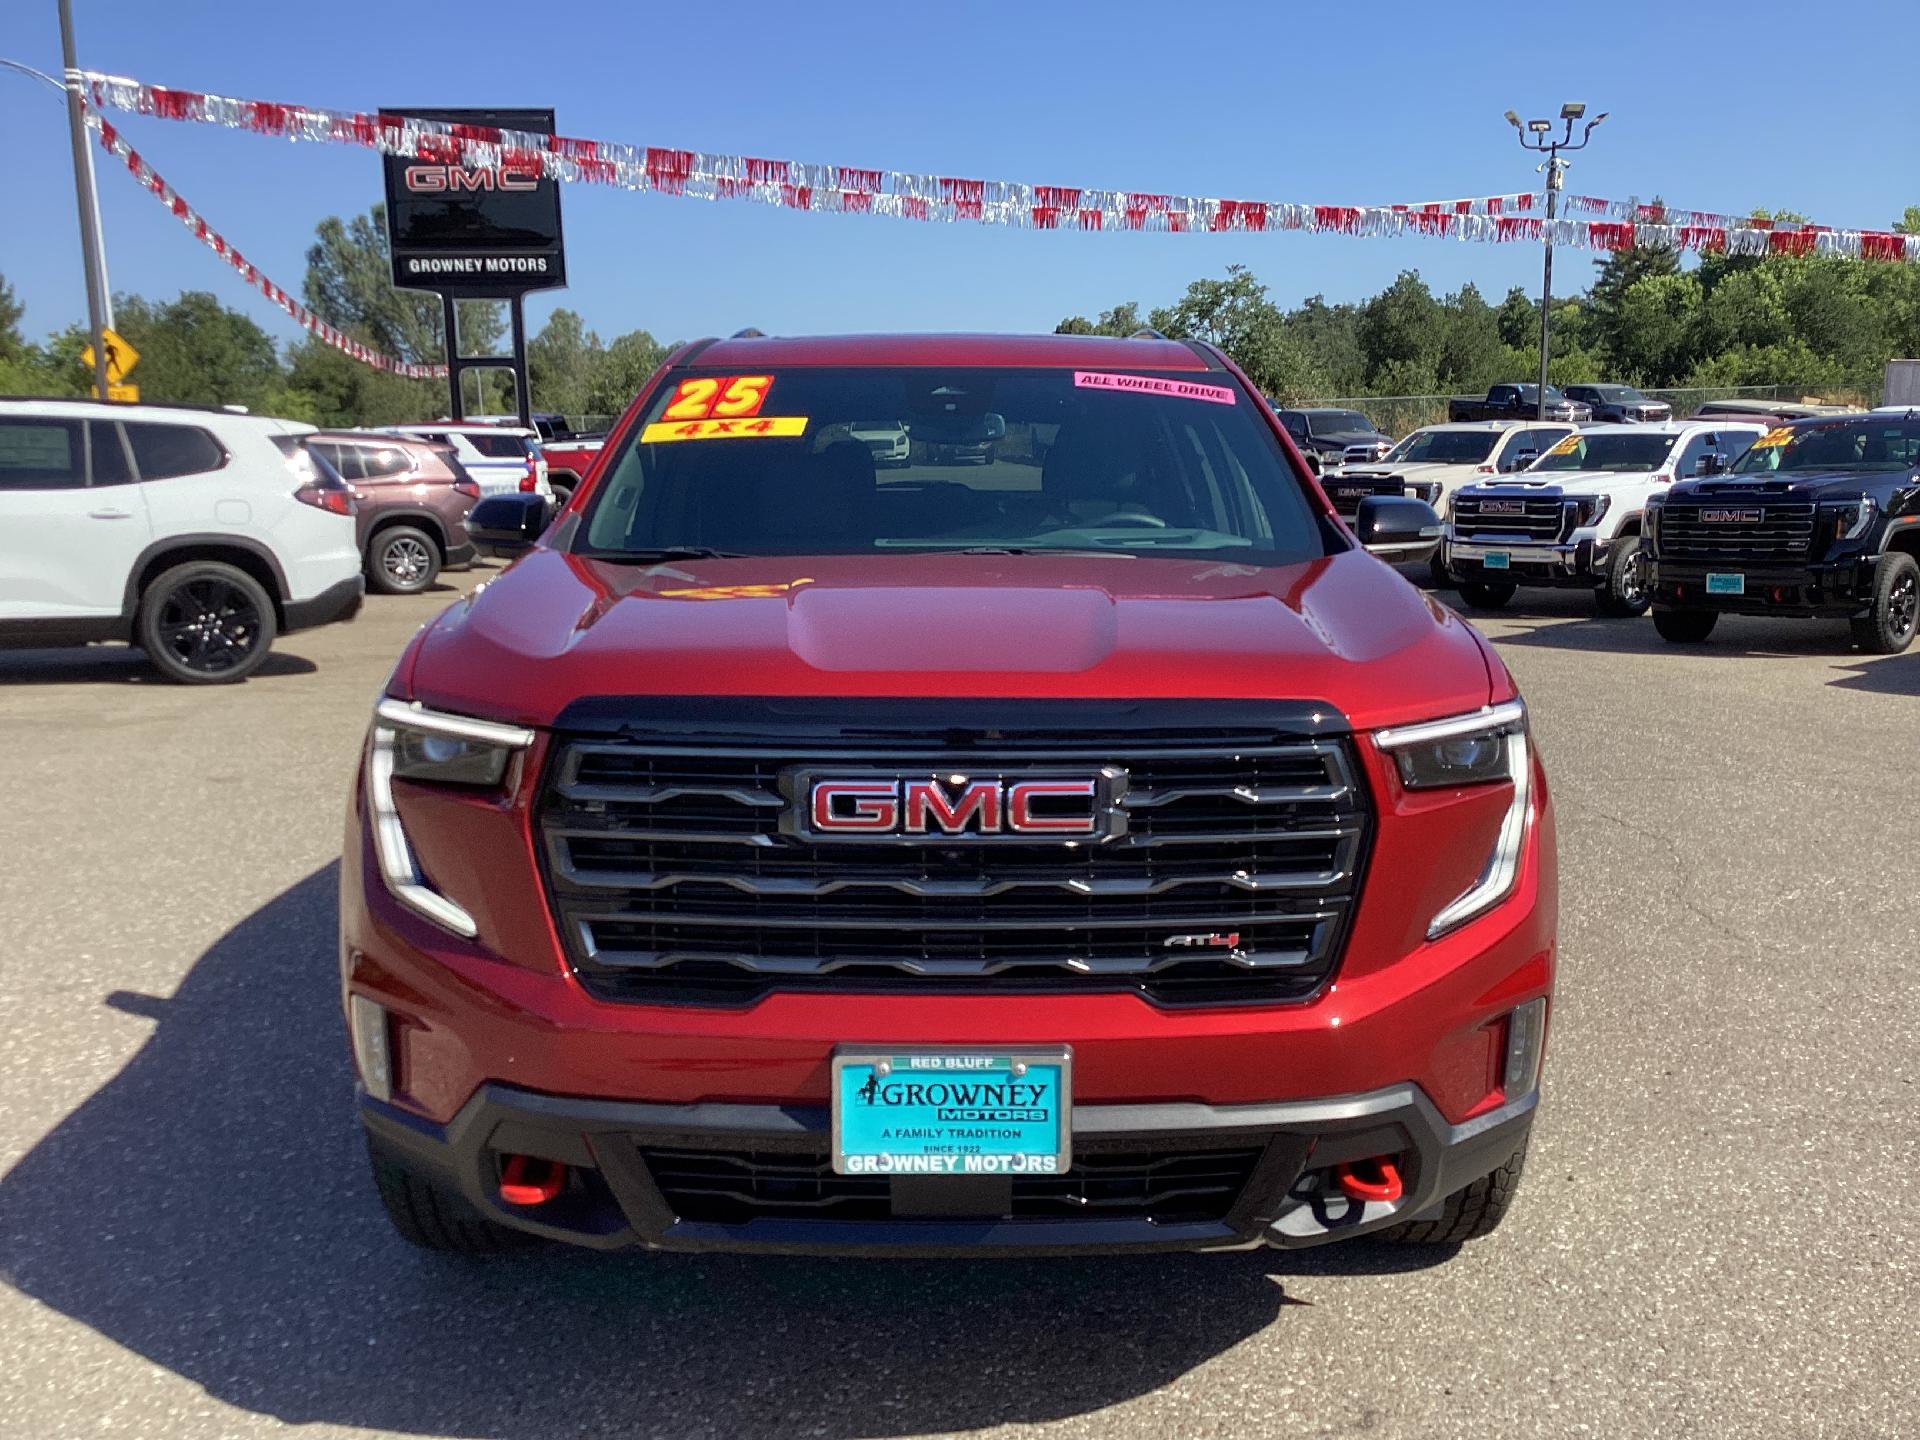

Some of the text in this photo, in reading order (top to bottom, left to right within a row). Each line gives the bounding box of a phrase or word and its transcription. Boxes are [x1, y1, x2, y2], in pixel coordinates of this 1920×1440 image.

[405, 165, 538, 192] GMC
[409, 257, 547, 273] GROWNEY MOTORS
[1081, 375, 1228, 399] ALL WHEEL DRIVE
[665, 376, 769, 418] 25
[1702, 510, 1759, 521] GMC
[811, 780, 1095, 832] GMC
[910, 1058, 994, 1069] RED BLUFF
[881, 1083, 1047, 1107] GROWNEY
[940, 1110, 1046, 1121] MOTORS
[883, 1128, 1022, 1139] A FAMILY TRADITION
[923, 1145, 954, 1153] SINCE
[847, 1155, 1057, 1172] GROWNEY MOTORS
